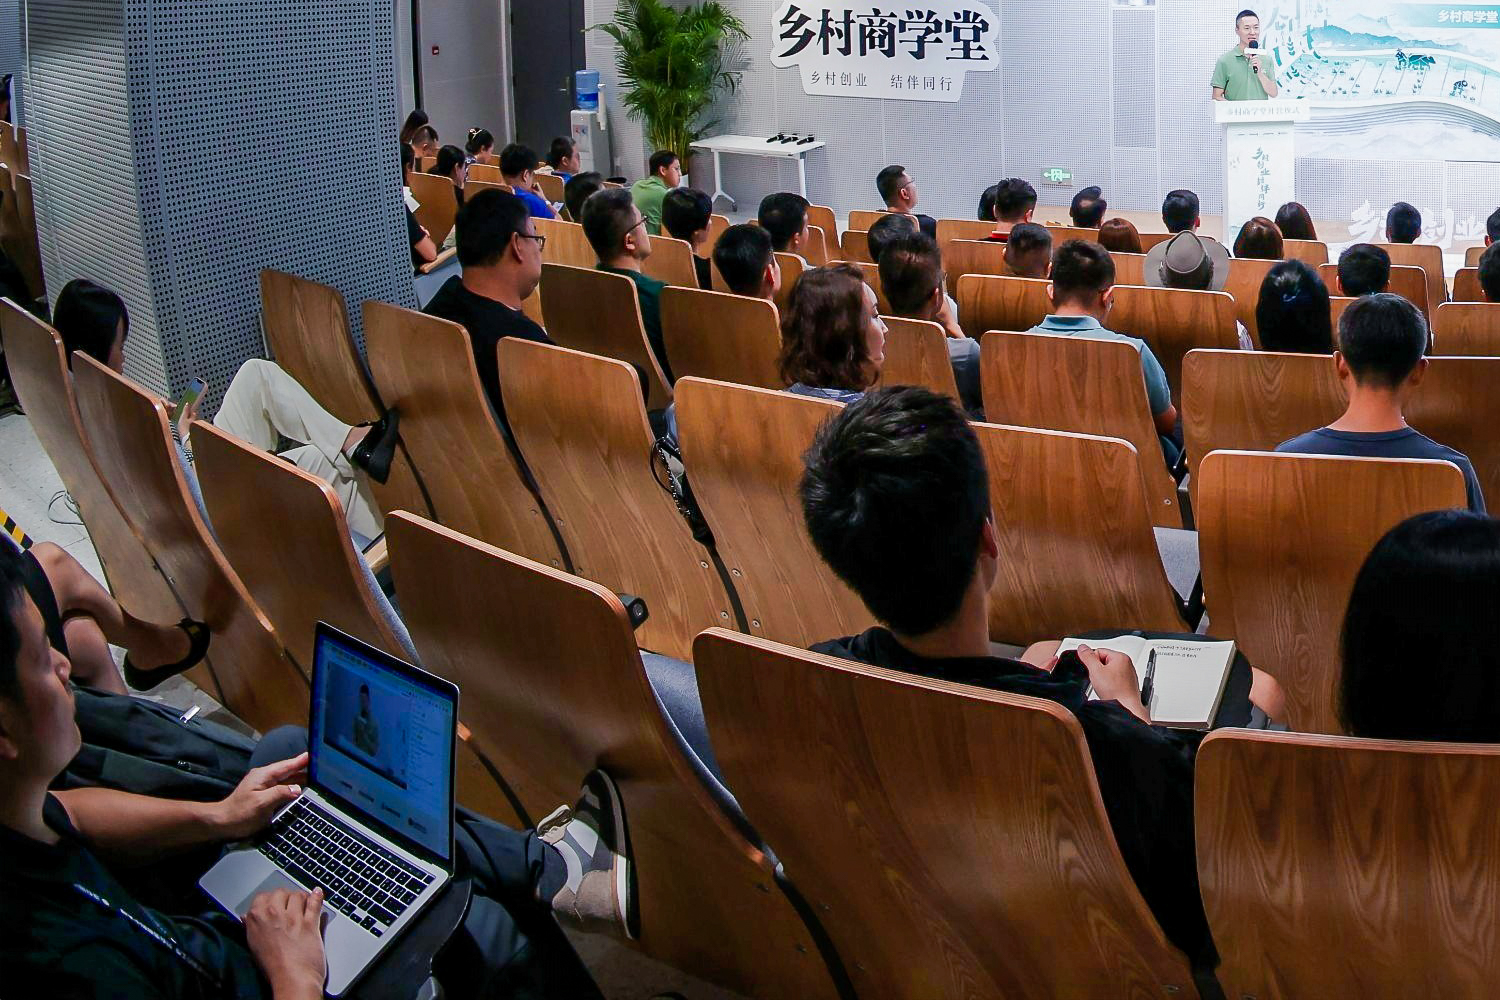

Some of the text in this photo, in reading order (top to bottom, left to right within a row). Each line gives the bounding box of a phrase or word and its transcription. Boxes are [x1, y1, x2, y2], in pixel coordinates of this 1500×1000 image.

[778, 4, 990, 61] 乡村商学堂
[810, 71, 953, 91] 乡村创业 结伴同行
